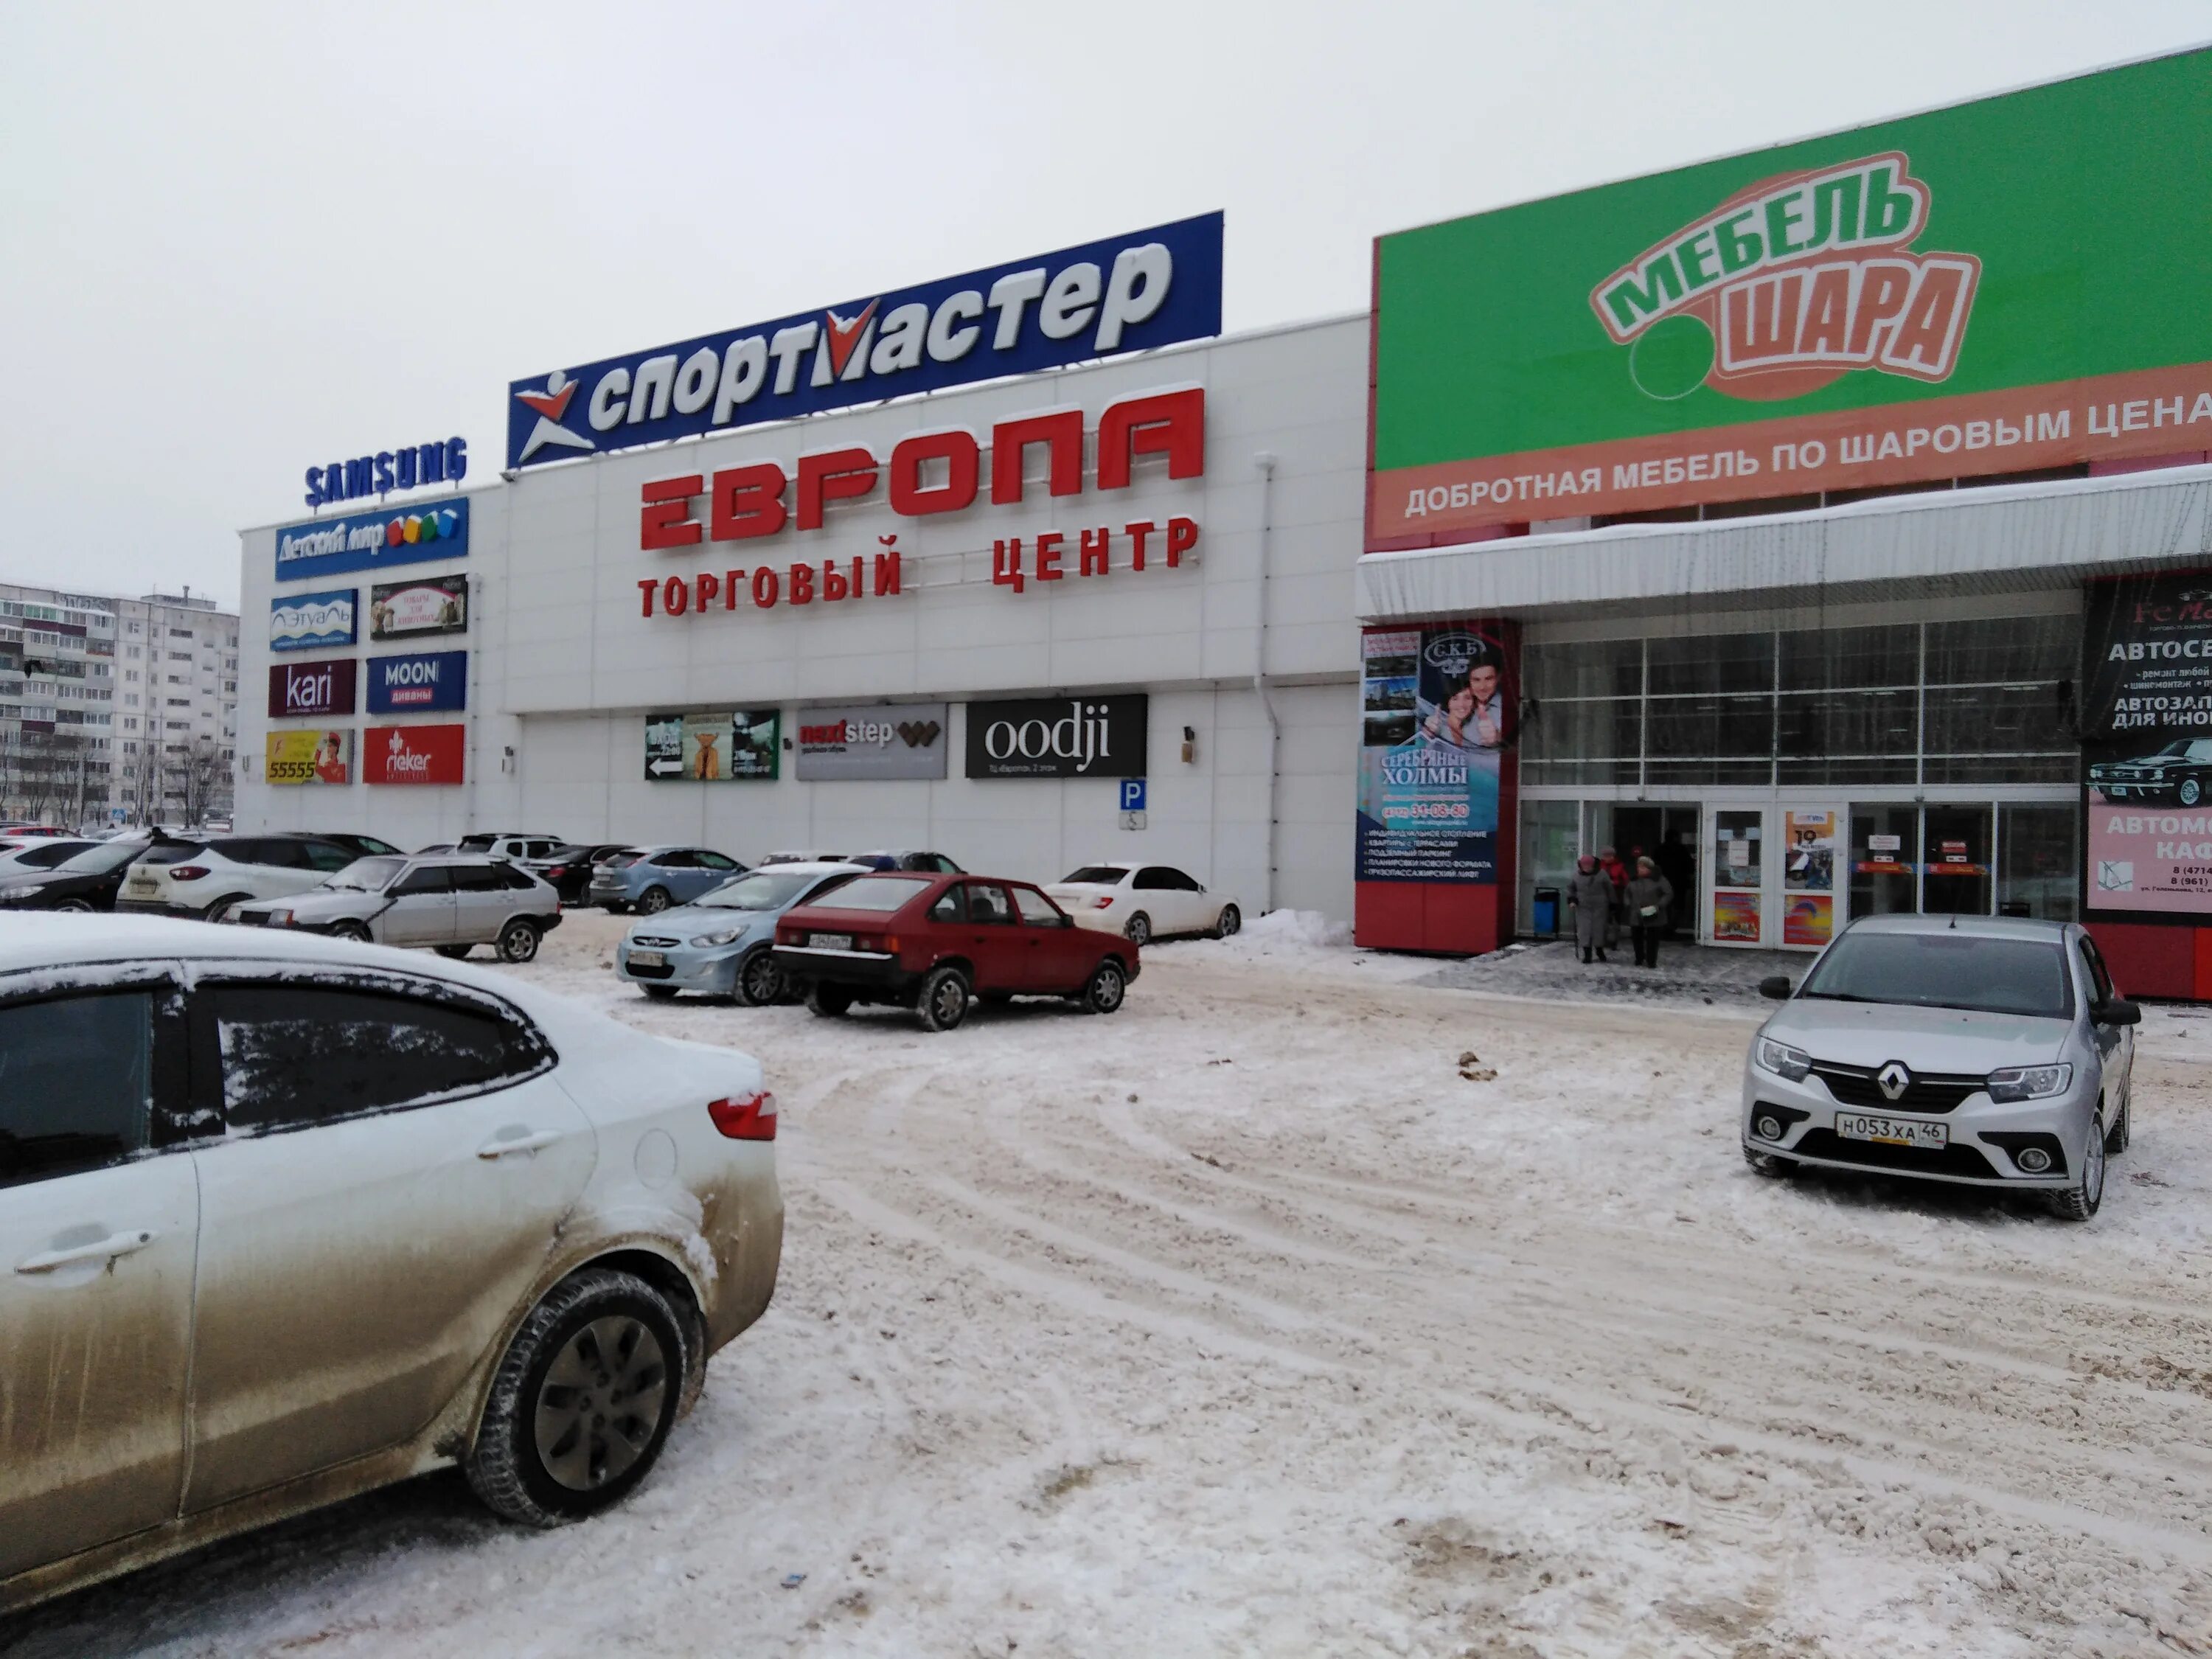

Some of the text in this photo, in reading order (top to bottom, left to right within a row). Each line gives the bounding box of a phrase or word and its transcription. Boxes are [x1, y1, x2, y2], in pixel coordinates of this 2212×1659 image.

[1604, 166, 1914, 330] МЕБЕЛЬ
[1727, 265, 1963, 368] ШАРА
[304, 436, 467, 507] SAMSUNG
[639, 383, 1205, 551] ЕВРОПА
[1405, 467, 1602, 518] ДОБРОТНАЯ
[1612, 450, 1760, 490] МЕБЕЛЬ
[1772, 440, 1827, 472] ПО
[1839, 409, 2070, 465] ШАРОВЫМ
[278, 522, 386, 563] Детский мир
[637, 516, 1198, 618] ТОРГОВЫЙ ЦЕНТР
[385, 661, 437, 686] MOON
[2142, 666, 2209, 679] ремонт любой
[286, 665, 332, 707] kari
[2130, 681, 2191, 690] шиномонтаж
[392, 689, 432, 703] диваны
[2112, 713, 2155, 730] ДЛЯ
[984, 701, 1112, 772] oodji
[386, 746, 431, 771] rieker
[1381, 749, 1467, 768] СЕРЕБРЯНЫЕ
[269, 762, 316, 779] 55555
[1382, 767, 1468, 785] ХОЛМЫ
[1125, 782, 1141, 807] P
[1368, 830, 1487, 838] ИНДИВИДУАЛЬНОЕ ОТОПЛЕНИЕ
[2107, 815, 2212, 835] АВТОМ
[1368, 859, 1419, 867] ПЛАНИРОВКИ
[1420, 860, 1453, 868] НОВОГО
[1368, 869, 1457, 878] ГРУЗОПАССАЖИРСКИЙ
[2180, 877, 2208, 886] (961)
[1921, 1124, 1940, 1138] 46
